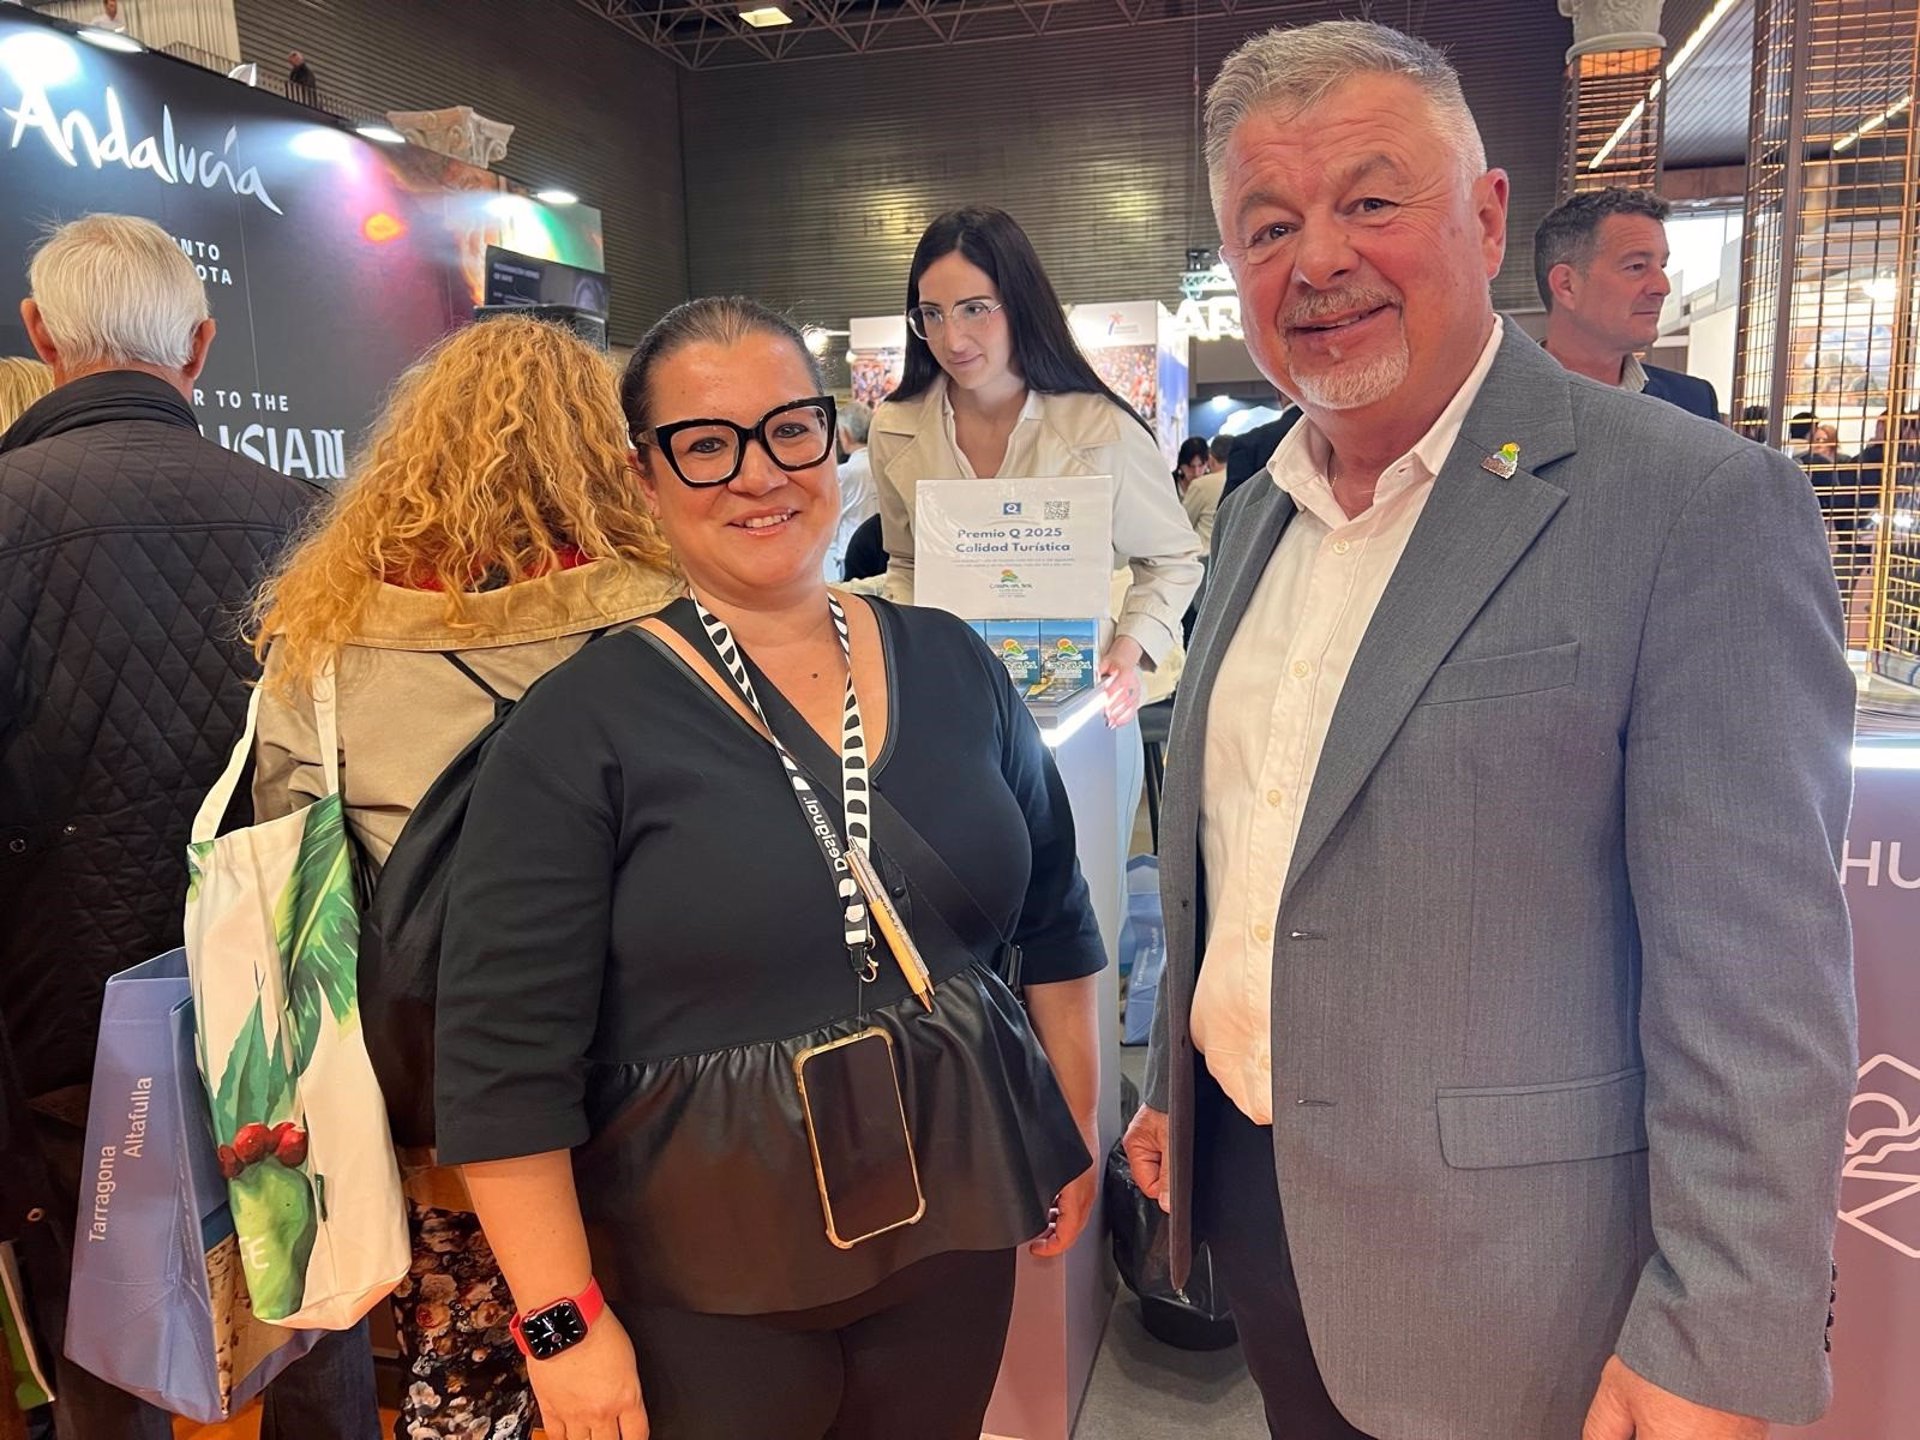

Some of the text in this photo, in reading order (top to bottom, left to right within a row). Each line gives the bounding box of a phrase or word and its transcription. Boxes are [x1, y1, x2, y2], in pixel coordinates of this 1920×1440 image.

[3, 82, 283, 216] Andalucía
[172, 236, 220, 261] NTO
[215, 390, 241, 409] TO
[252, 392, 288, 412] THE
[958, 527, 1063, 539] Premio Q 2025
[955, 541, 1071, 553] Calidad Turística
[123, 1076, 152, 1158] Altafulla
[89, 1145, 116, 1242] Tarragona
